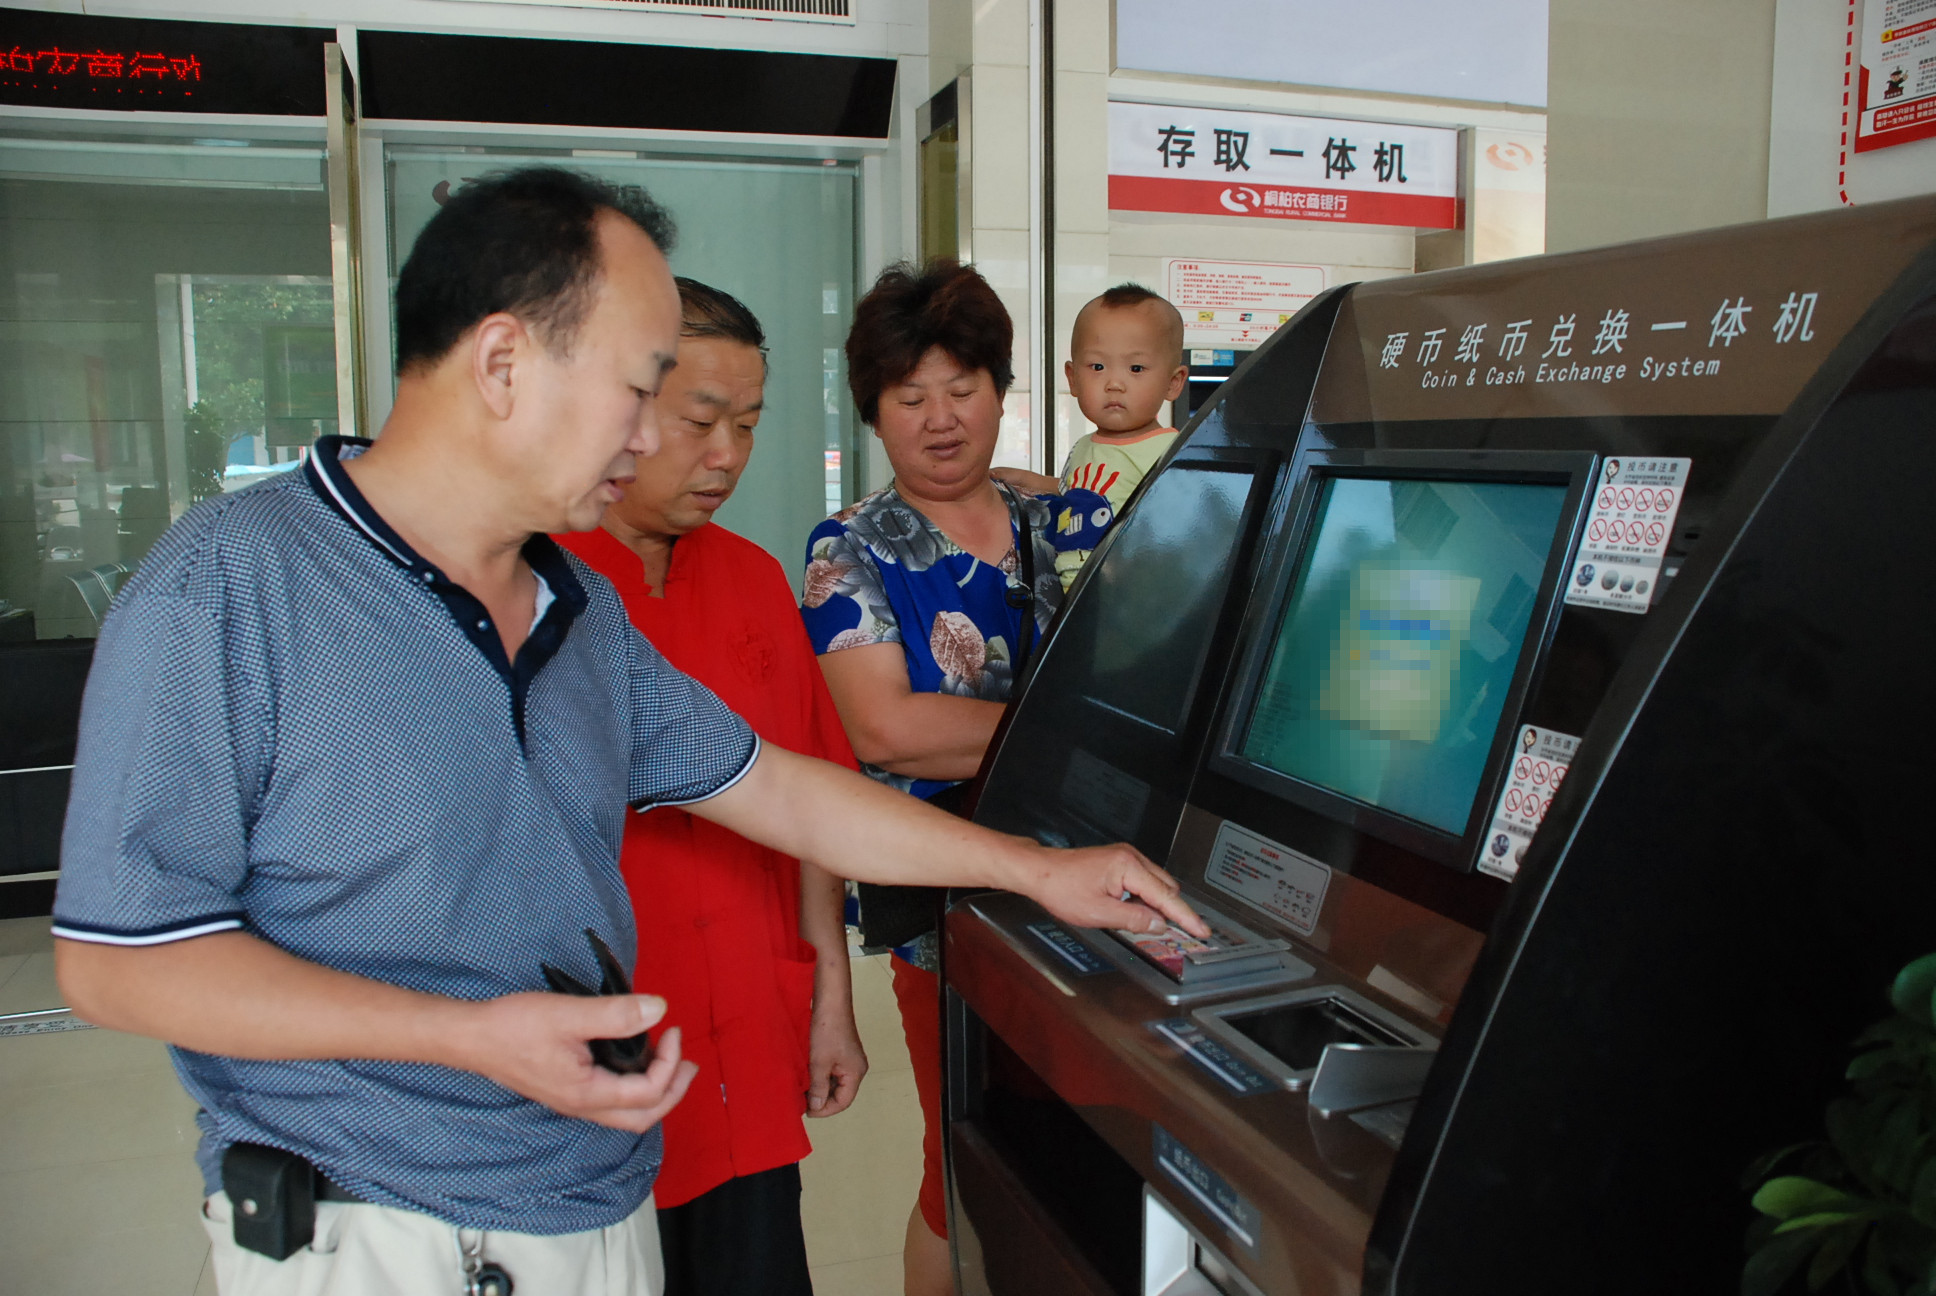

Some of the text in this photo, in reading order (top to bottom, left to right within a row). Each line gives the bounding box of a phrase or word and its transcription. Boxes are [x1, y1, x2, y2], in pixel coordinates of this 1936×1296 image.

[1157, 125, 1408, 183] 存取一体机
[1264, 190, 1348, 211] 桐柏农商银行
[1380, 292, 1818, 369] 硬币纸币兑换一体机
[1422, 356, 1721, 389] Coin & Cash Exchange System
[1543, 735, 1579, 751] 投币请
